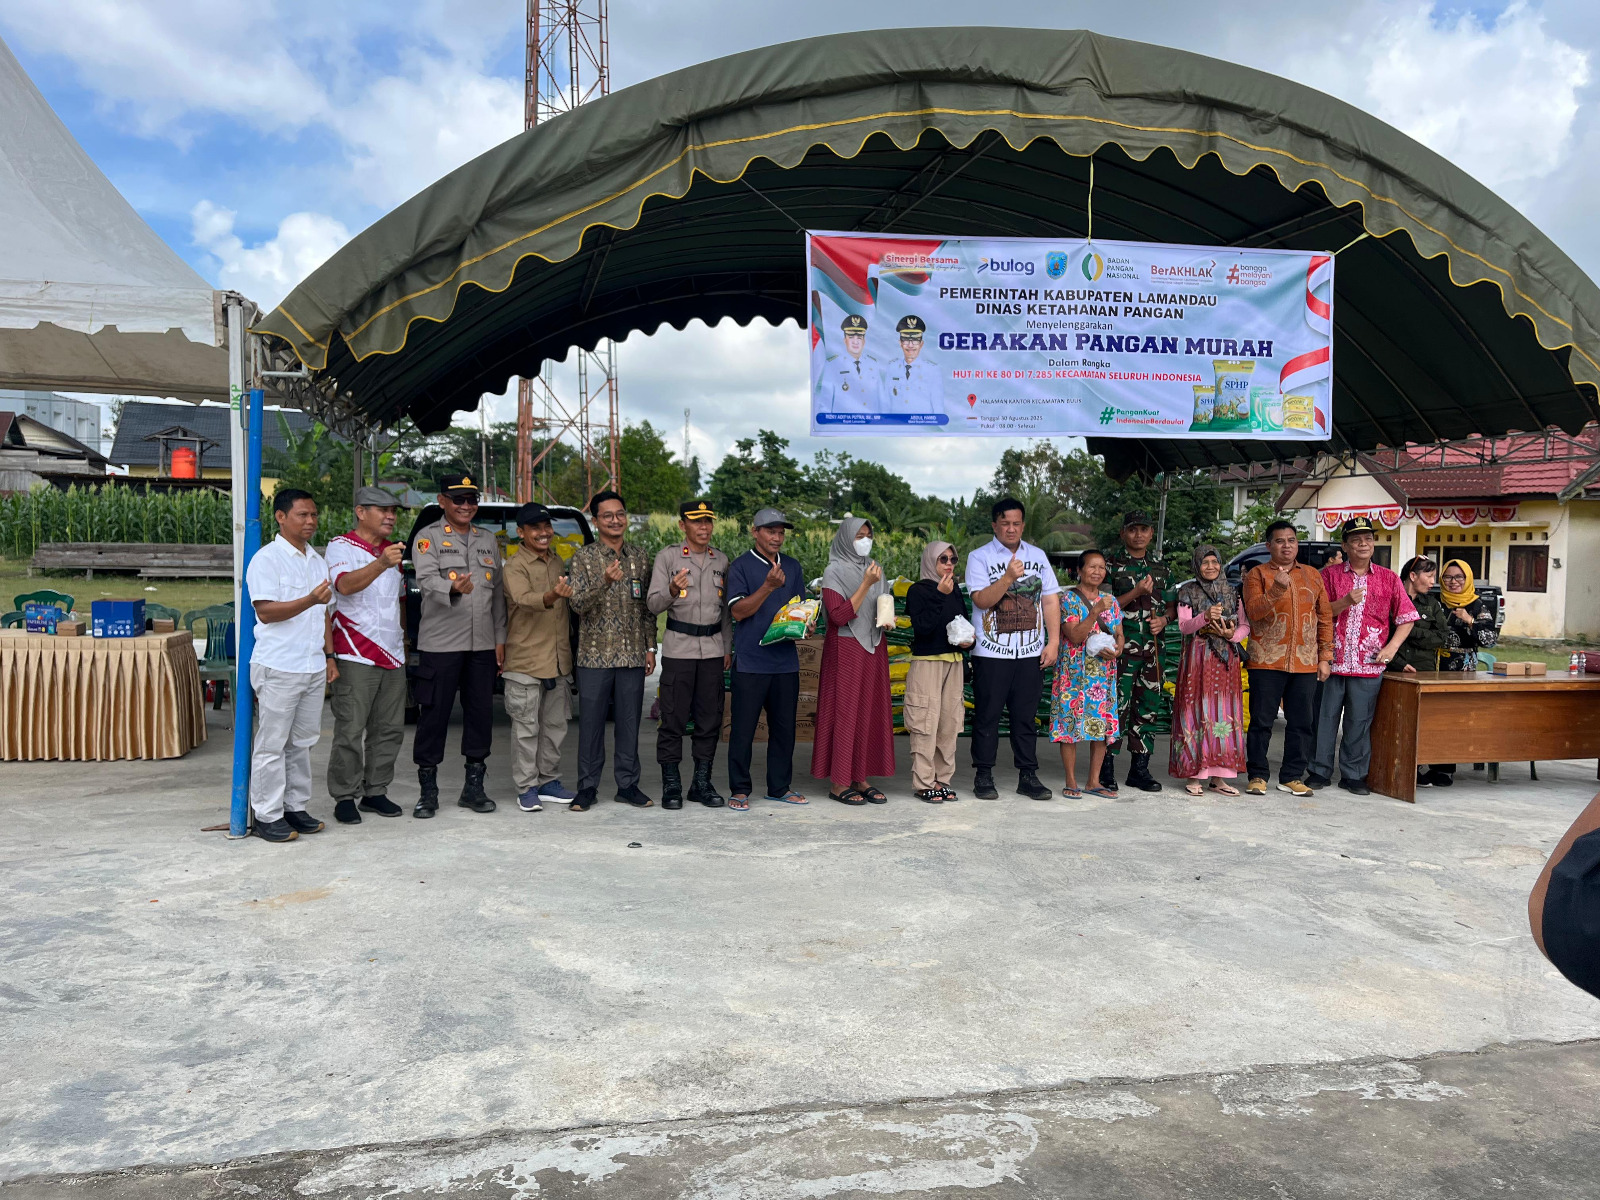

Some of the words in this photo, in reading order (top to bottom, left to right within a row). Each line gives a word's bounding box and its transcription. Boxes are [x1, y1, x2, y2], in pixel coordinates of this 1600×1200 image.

[886, 254, 918, 265] Sinergi
[920, 256, 959, 264] Bersama
[1107, 257, 1130, 265] BADAN
[990, 258, 1035, 276] bulog
[1150, 264, 1213, 278] BerAKHLAK
[1240, 264, 1267, 272] bangga
[1106, 272, 1140, 280] NASIONAL
[1240, 279, 1267, 287] bangsa
[939, 287, 1039, 301] PEMERINTAH
[1043, 288, 1133, 303] KABUPATEN
[1138, 292, 1217, 307] LAMANDAU
[975, 303, 1022, 315] DINAS
[1026, 303, 1119, 318] KETAHANAN
[1123, 306, 1184, 320] PANGAN
[1026, 320, 1113, 331] Menyelenggarakan
[938, 333, 1067, 351] GERAKAN
[1075, 333, 1179, 354] PANGAN
[1184, 338, 1274, 357] MURAH
[1048, 358, 1078, 368] Dalam
[1082, 359, 1111, 370] Rangka
[953, 371, 973, 379] HUT
[975, 371, 984, 379] RI
[987, 371, 999, 379] KE
[1000, 371, 1012, 379] 80
[1014, 371, 1025, 379] DI
[1027, 371, 1053, 379] 7.285
[1055, 371, 1107, 380] KECAMATAN
[1109, 372, 1149, 381] SELURUH
[1152, 373, 1202, 382] INDONESIA
[1224, 380, 1249, 389] SPHP
[980, 640, 1014, 656] BAHAUM
